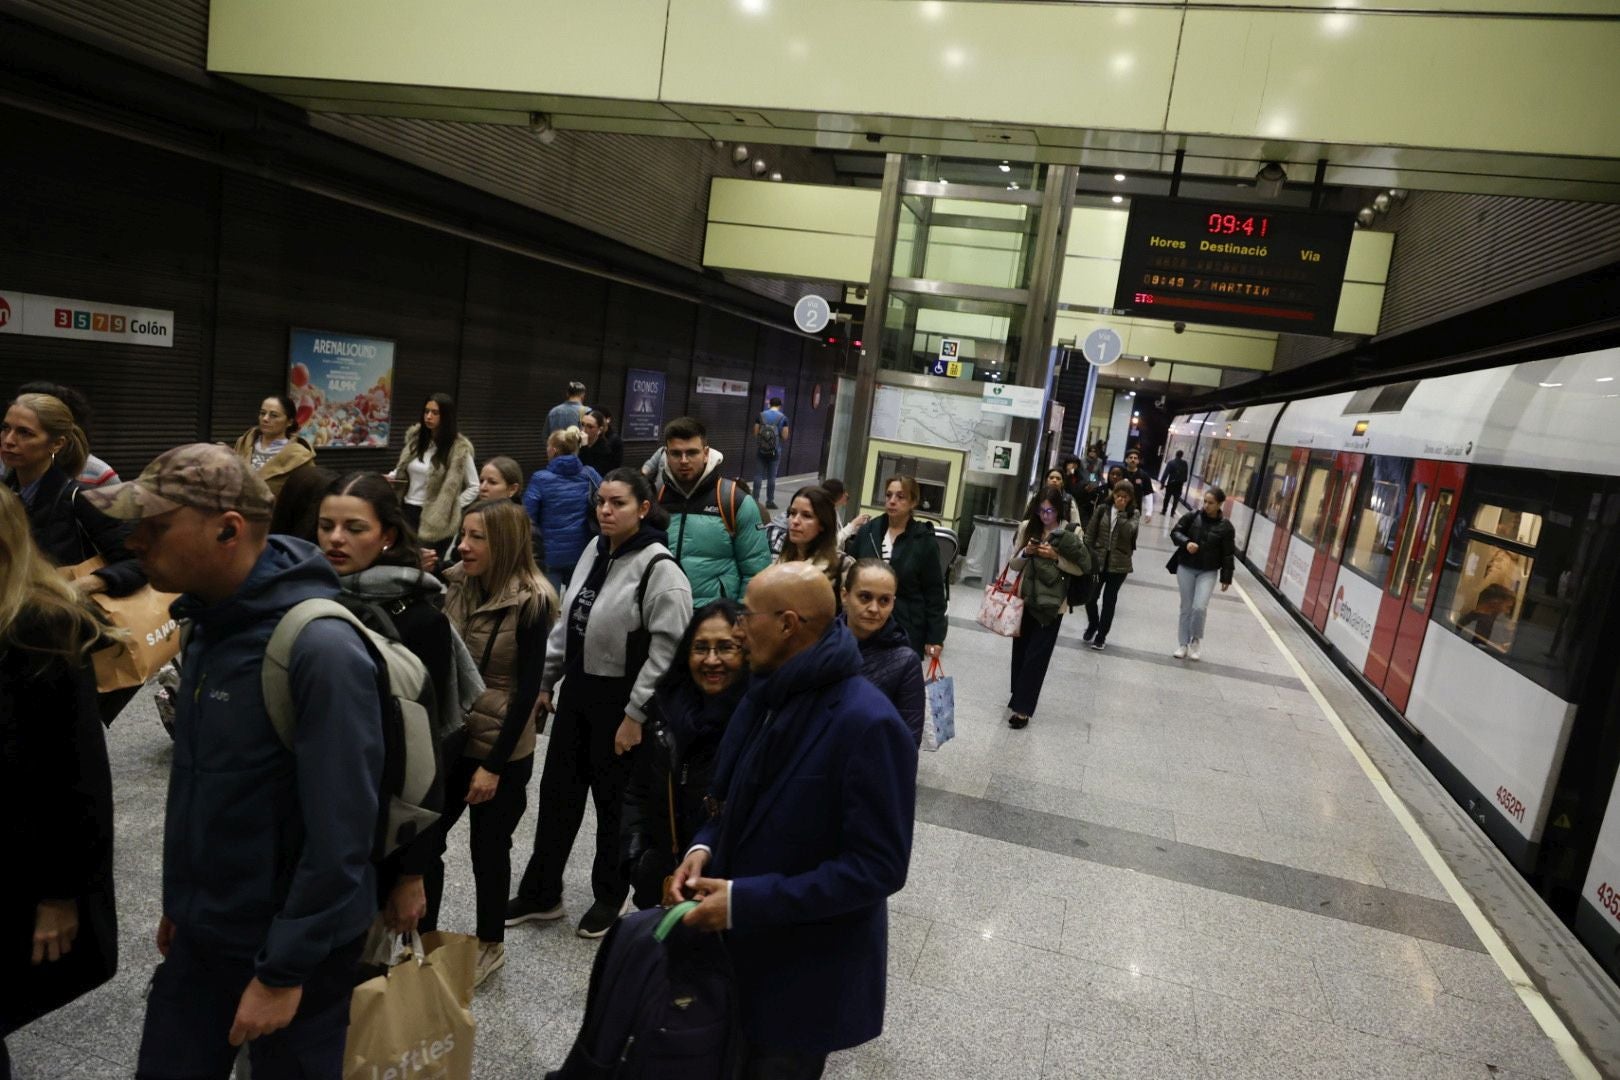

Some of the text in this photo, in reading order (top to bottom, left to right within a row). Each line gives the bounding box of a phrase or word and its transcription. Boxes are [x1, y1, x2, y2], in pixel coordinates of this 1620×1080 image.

[1207, 213, 1269, 237] 09:41
[1149, 236, 1321, 262] Hores Destinació Via
[59, 312, 167, 336] 3 5 7 9 Colón
[806, 310, 818, 328] 2
[1097, 342, 1107, 361] 1
[1496, 785, 1526, 823] 4352R1
[372, 1033, 455, 1080] lefties
